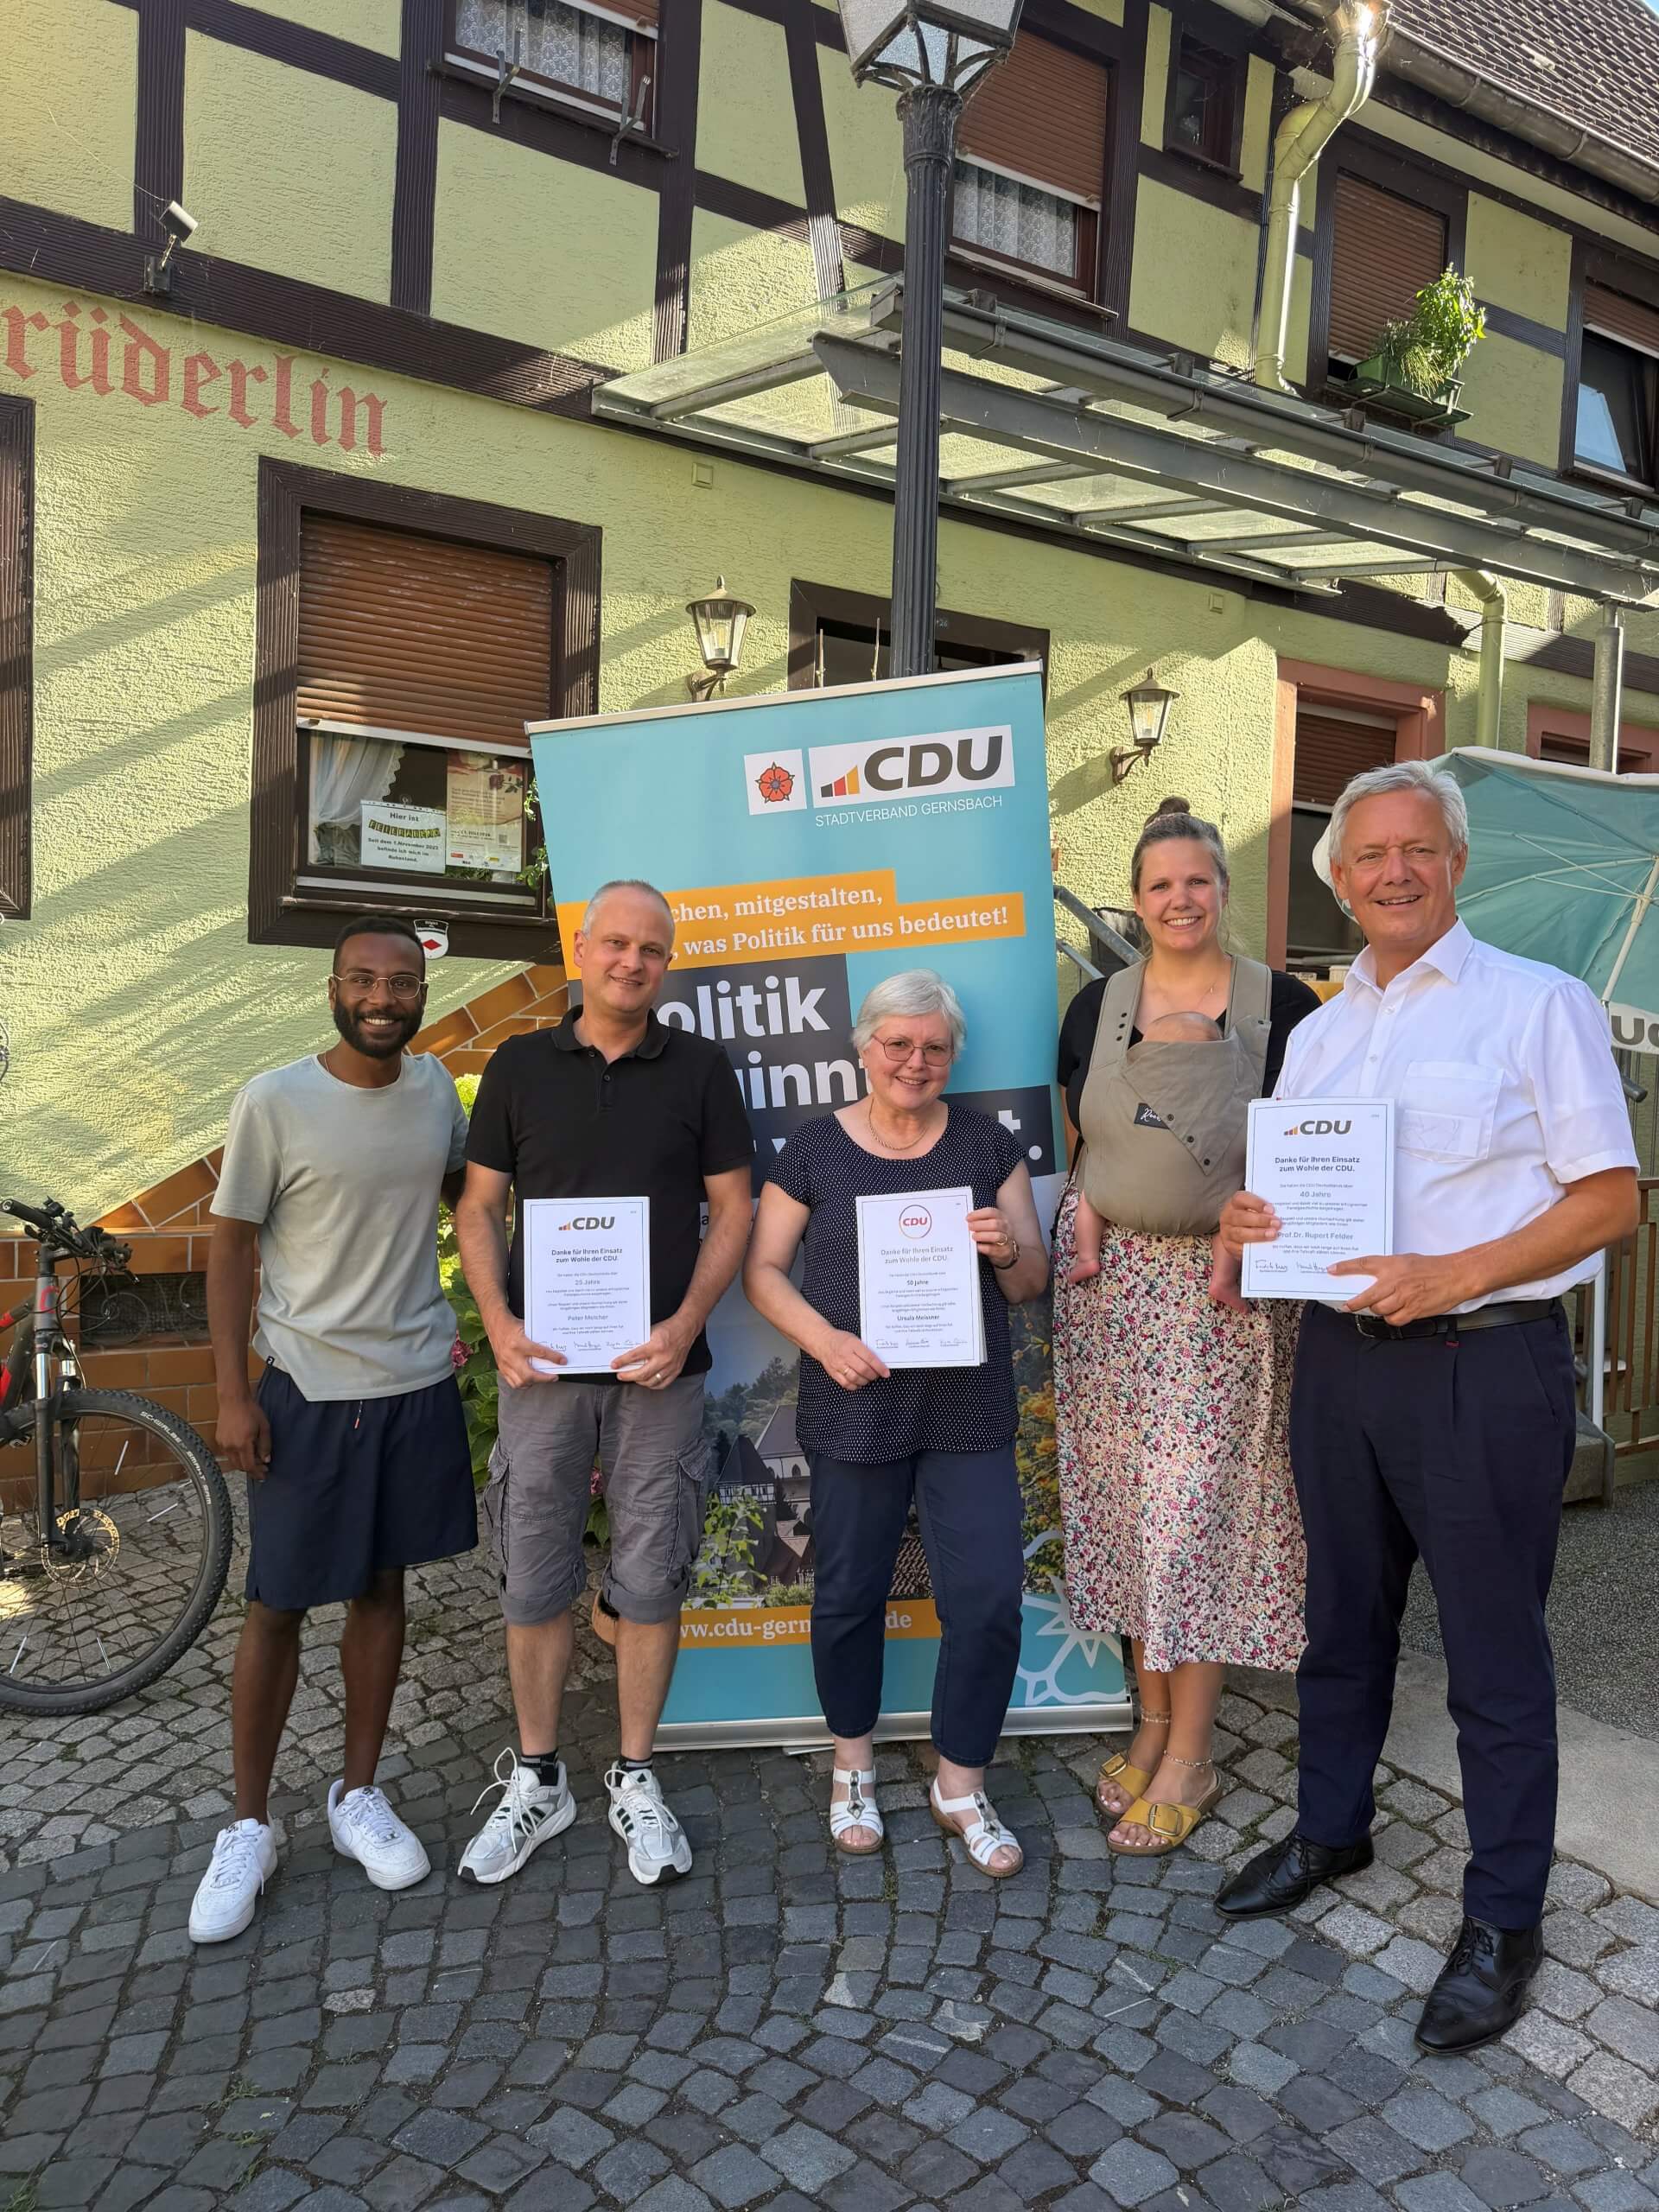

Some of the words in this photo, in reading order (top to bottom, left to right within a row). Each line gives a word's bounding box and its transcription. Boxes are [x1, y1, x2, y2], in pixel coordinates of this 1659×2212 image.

[864, 734, 1003, 791] CDU
[815, 804, 918, 827] STADTVERBAND
[921, 795, 1003, 816] GERNSBACH
[734, 887, 883, 917] mitgestalten,
[683, 938, 727, 956] was
[733, 925, 805, 950] Politik
[810, 923, 847, 944] für
[852, 921, 894, 940] uns
[899, 906, 1008, 935] bedeutet!
[656, 976, 831, 1040] olitik
[1300, 1120, 1352, 1135] CDU
[572, 1217, 615, 1230] CDU
[903, 1217, 928, 1226] CDU
